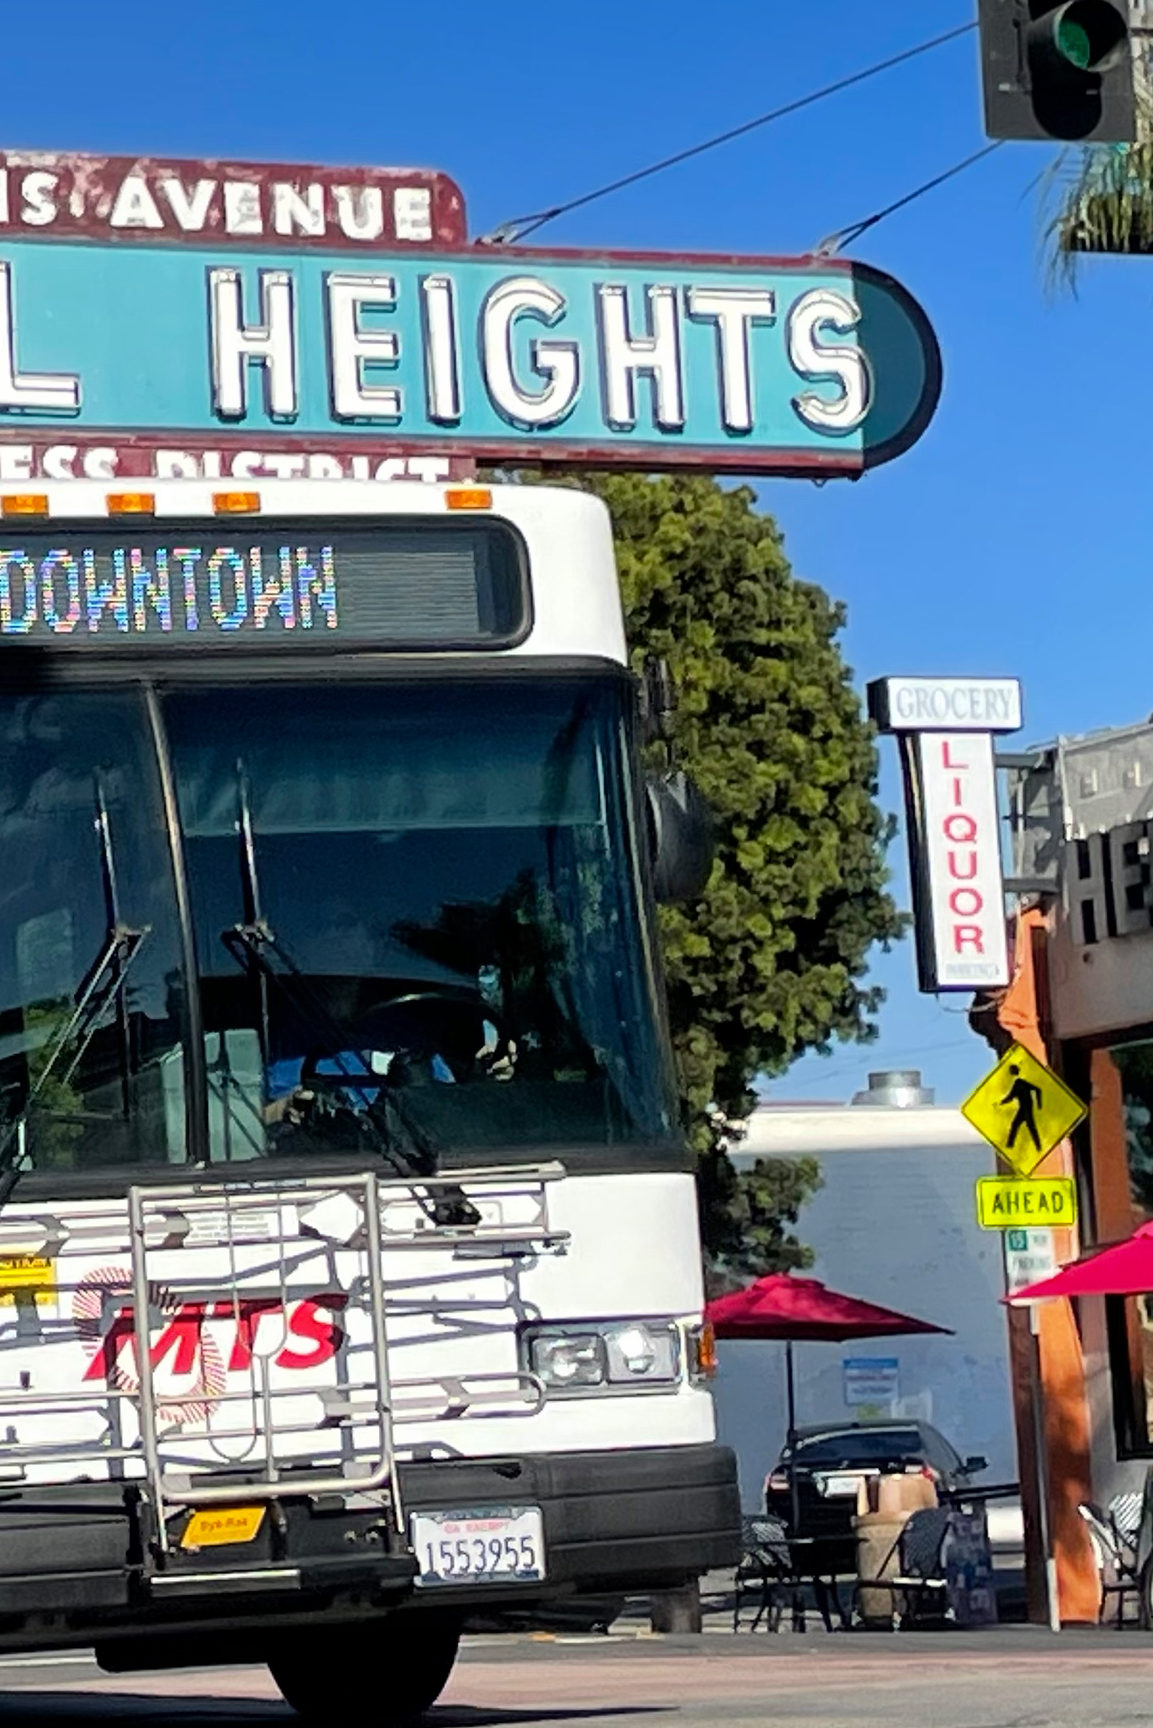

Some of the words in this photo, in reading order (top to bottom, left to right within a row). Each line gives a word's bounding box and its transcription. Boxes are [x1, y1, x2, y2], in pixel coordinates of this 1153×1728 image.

[110, 176, 434, 241] AVENUE
[205, 265, 872, 436] HEIGHTS
[896, 687, 1013, 719] GROCERY
[942, 741, 985, 954] LIQUOR
[992, 1191, 1064, 1215] AHEAD
[82, 1293, 350, 1382] MTS
[426, 1535, 536, 1575] 1553955
